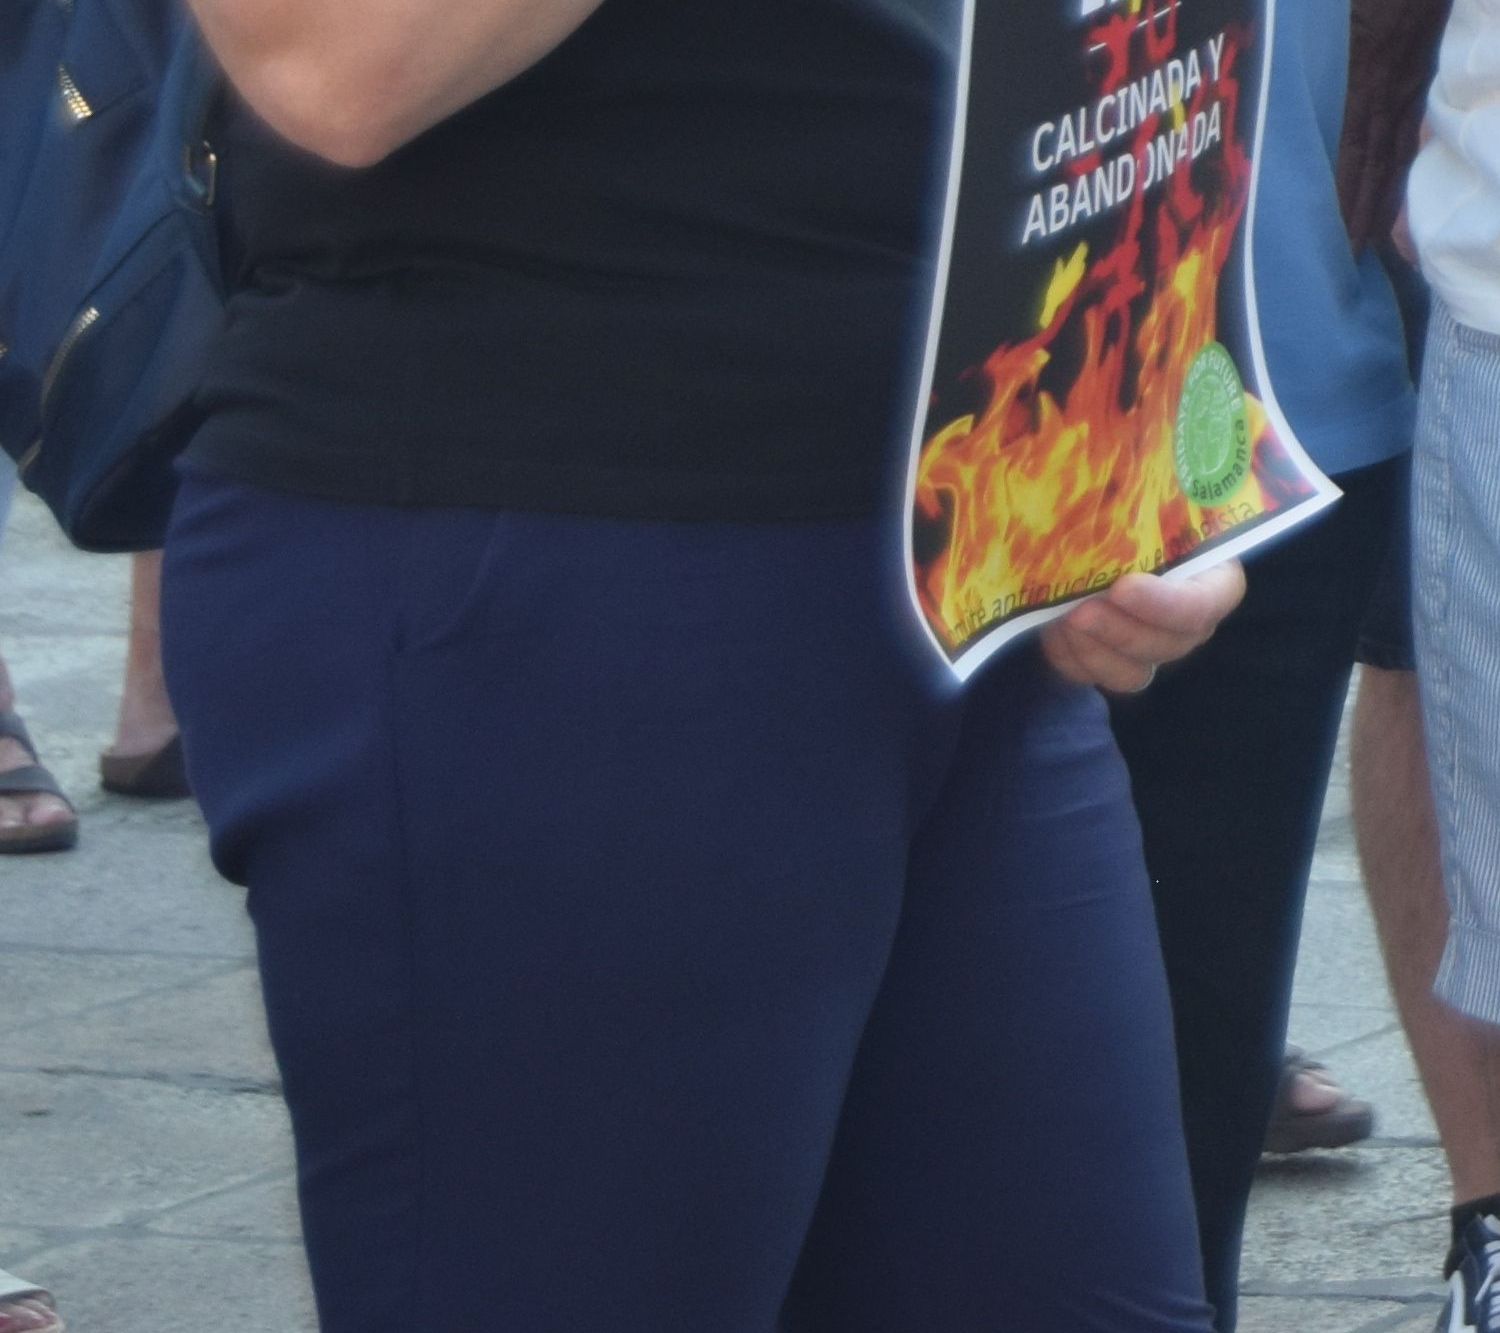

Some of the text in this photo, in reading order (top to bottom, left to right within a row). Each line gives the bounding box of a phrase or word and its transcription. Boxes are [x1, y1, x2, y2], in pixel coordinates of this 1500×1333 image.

[1031, 33, 1224, 171] CALCINADA Y
[1191, 418, 1248, 502] Salamanca
